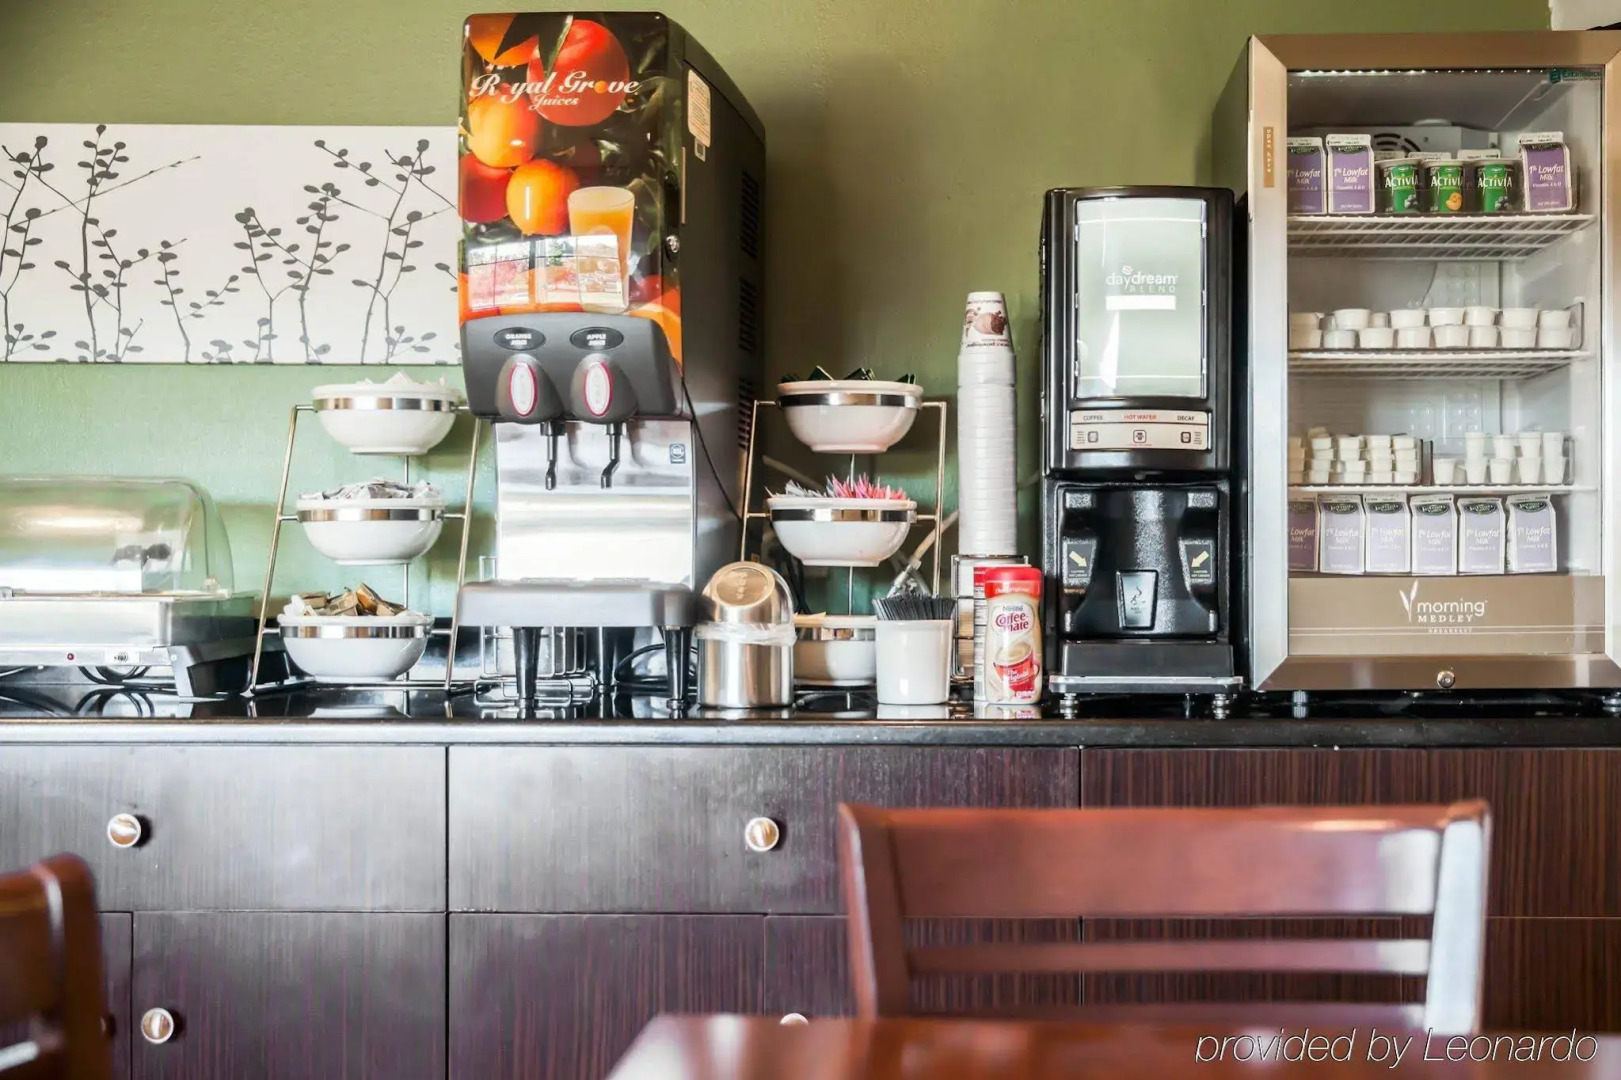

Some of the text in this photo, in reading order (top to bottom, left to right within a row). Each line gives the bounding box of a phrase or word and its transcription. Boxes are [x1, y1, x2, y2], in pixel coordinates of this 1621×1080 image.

[529, 94, 579, 110] Juices
[1295, 169, 1320, 178] Lowfat
[1342, 167, 1368, 178] Lowfat
[1538, 164, 1564, 174] Lowfat
[1477, 176, 1512, 188] ACTIVIA
[1106, 272, 1176, 290] daydream
[1290, 528, 1315, 538] Lowfat
[1334, 528, 1358, 540] Lowfat
[1474, 528, 1500, 540] Lowfat
[1525, 526, 1551, 539] Lowfat
[1417, 598, 1485, 617] morning
